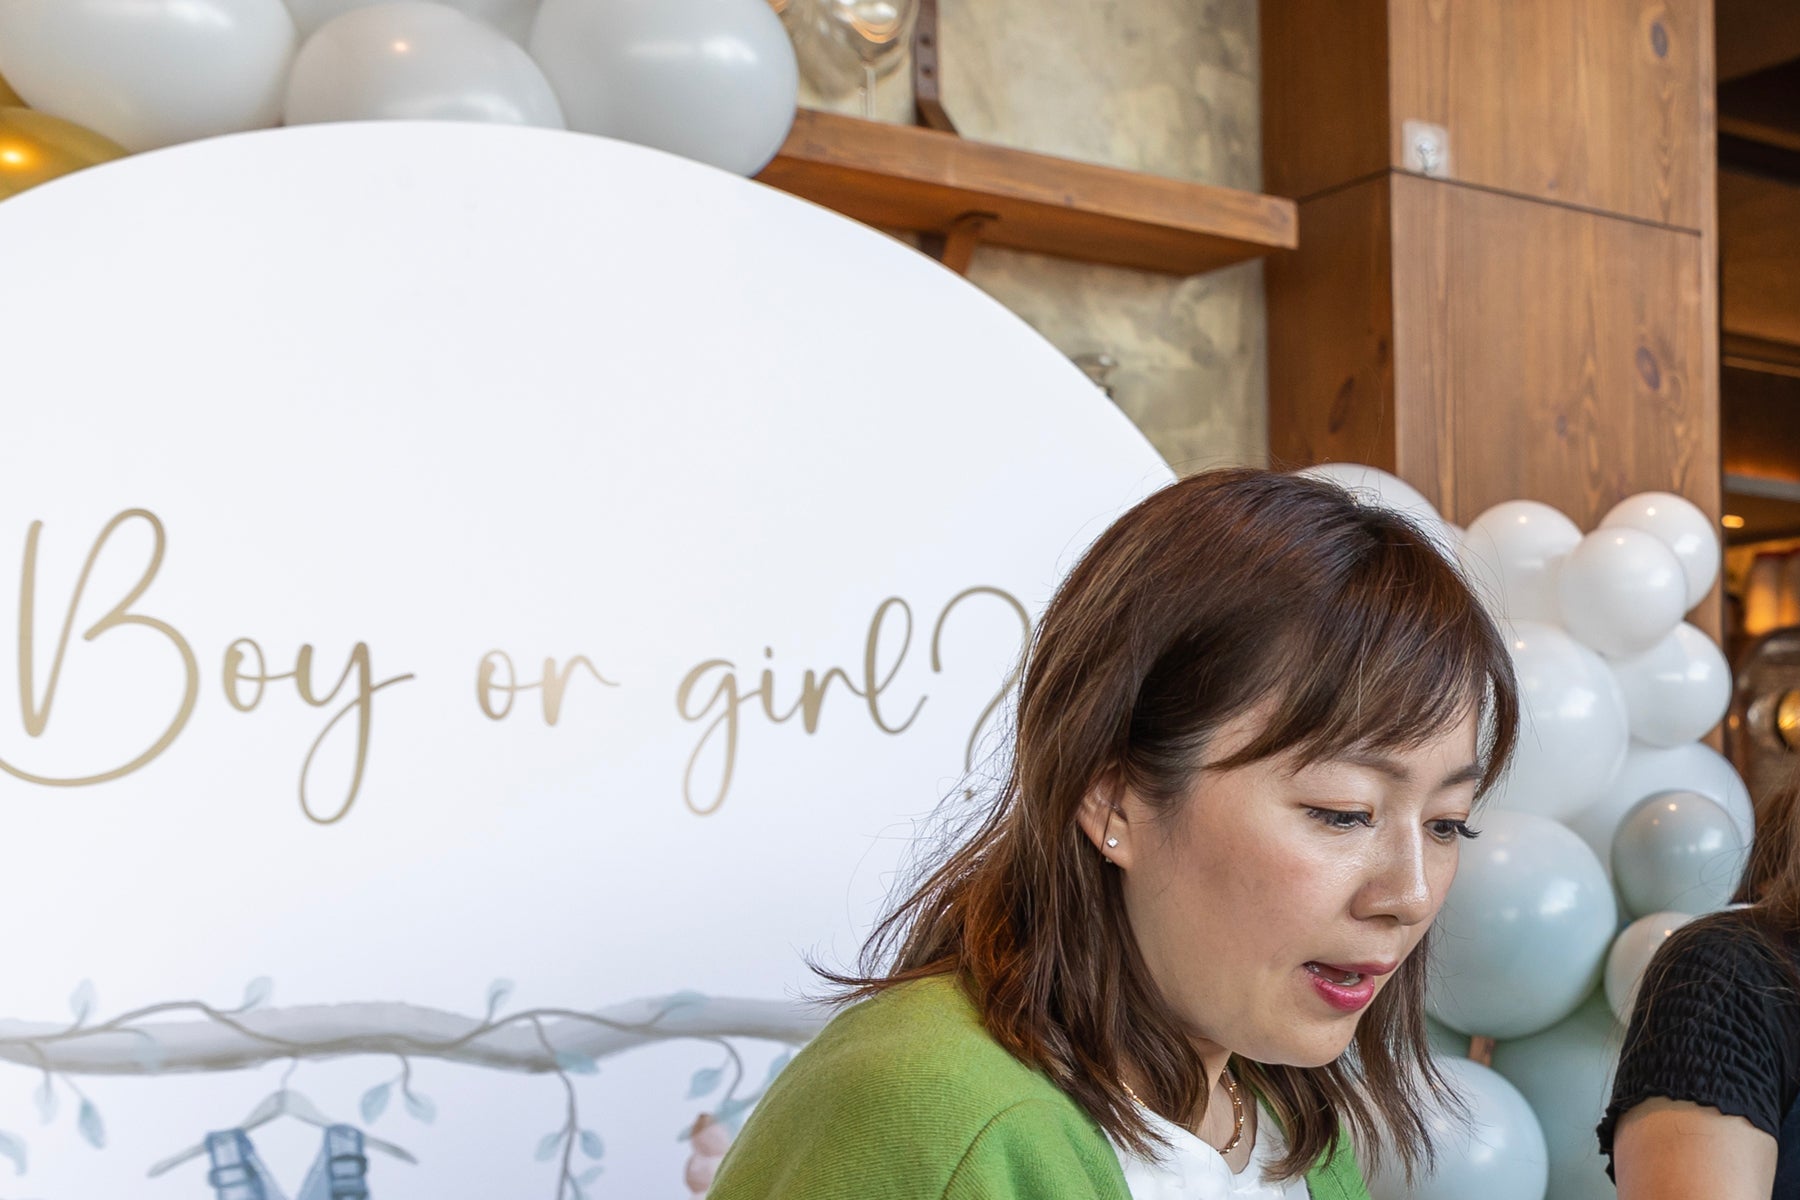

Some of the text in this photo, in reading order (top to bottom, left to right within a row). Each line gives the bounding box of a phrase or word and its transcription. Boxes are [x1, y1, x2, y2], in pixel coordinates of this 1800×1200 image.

[0, 507, 1033, 825] Boy or girl?
